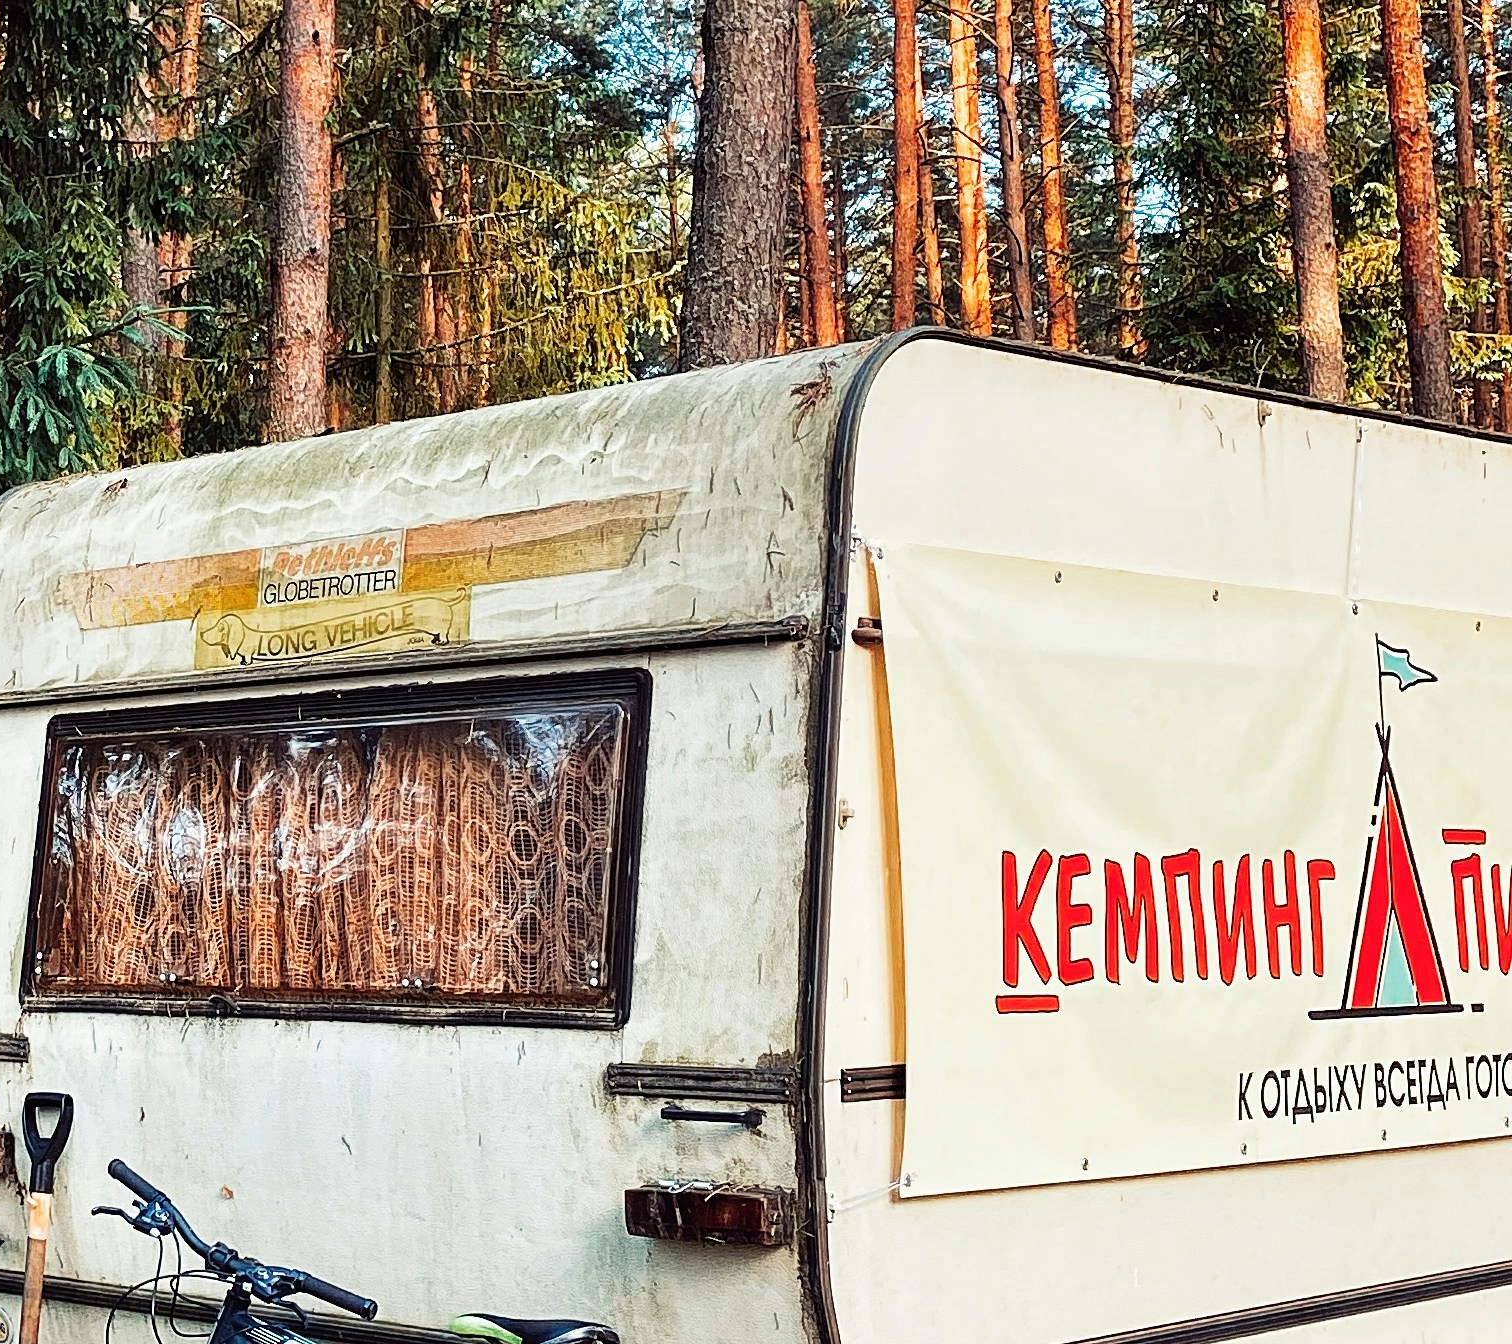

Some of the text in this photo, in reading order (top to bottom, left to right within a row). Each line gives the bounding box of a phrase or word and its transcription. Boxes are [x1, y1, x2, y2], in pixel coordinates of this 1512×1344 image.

[264, 569, 397, 605] GLOBETROTTER
[257, 605, 415, 657] LONG VEHICLE
[1001, 848, 1335, 987] КЕМПИНГ
[1238, 1072, 1254, 1120] К
[1261, 1063, 1366, 1124] ОТДЫХУ
[1374, 1058, 1460, 1111] ВСЕГДА
